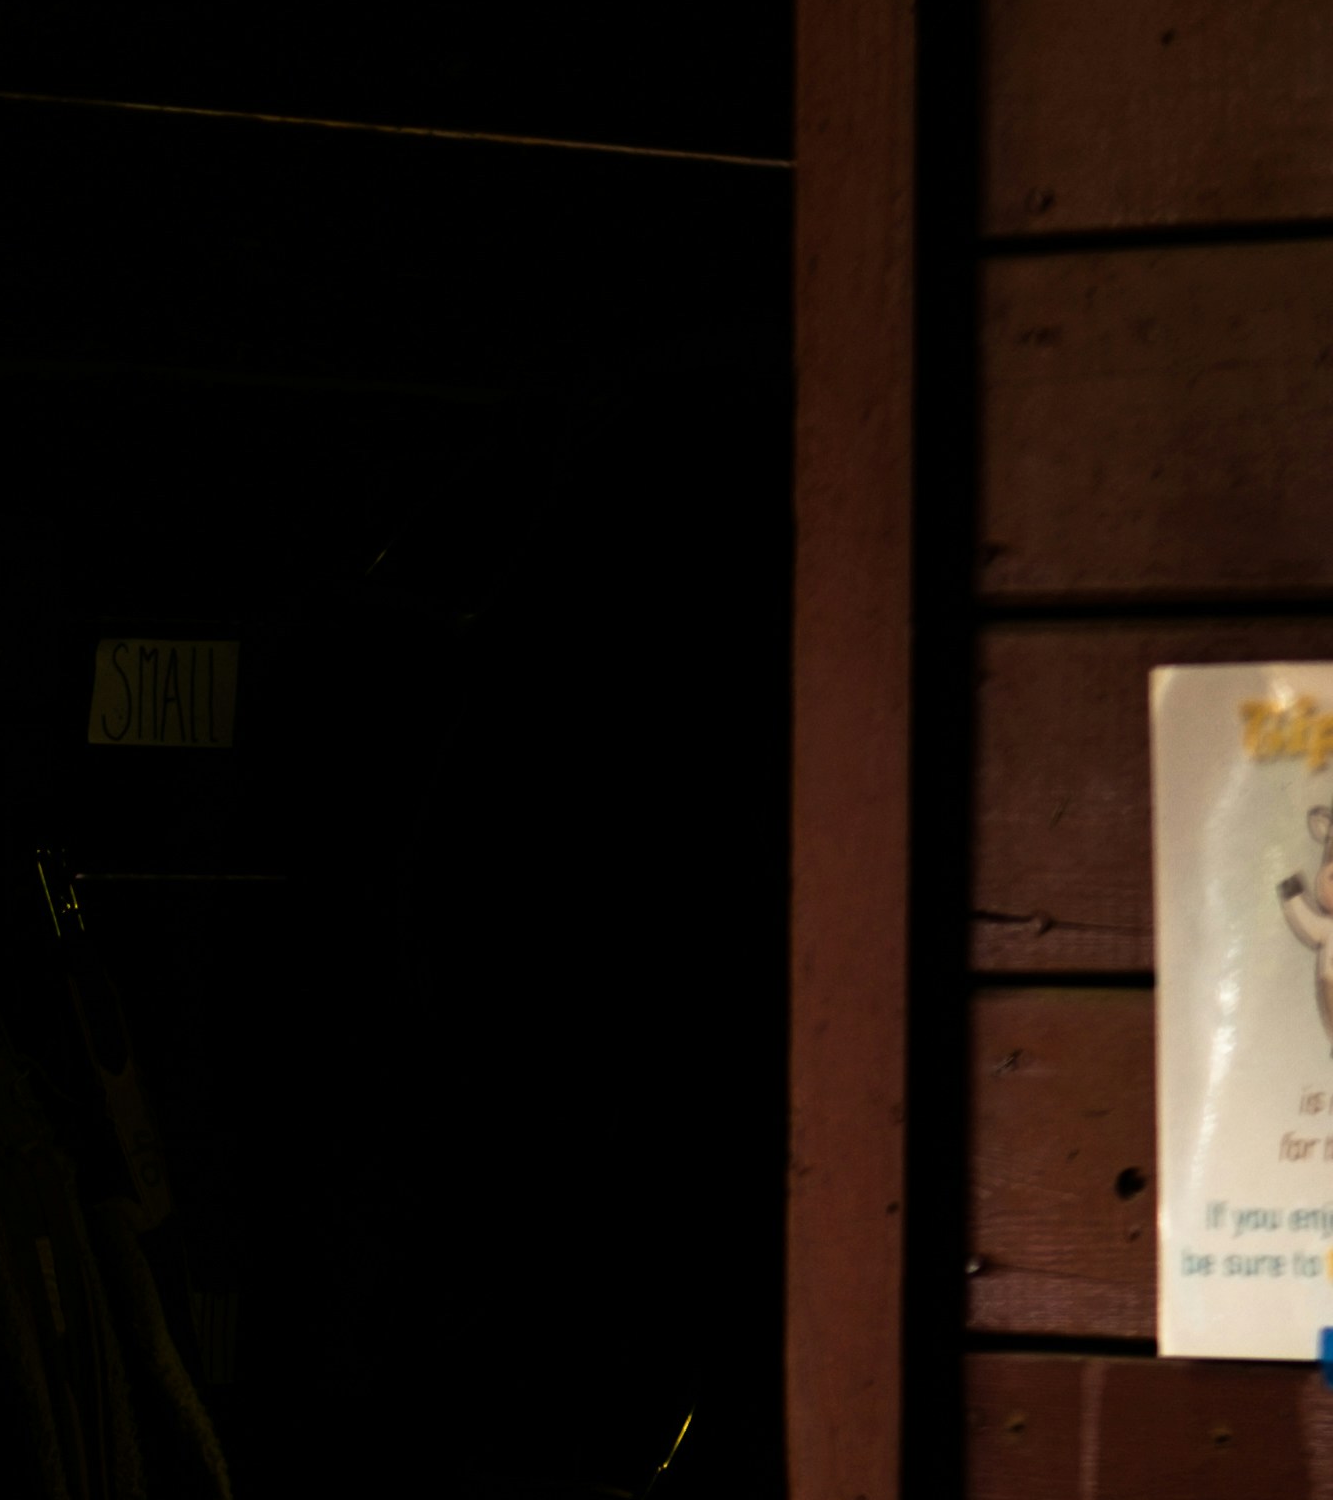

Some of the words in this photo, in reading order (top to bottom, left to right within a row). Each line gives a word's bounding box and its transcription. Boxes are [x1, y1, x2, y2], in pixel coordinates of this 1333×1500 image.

[101, 641, 220, 743] SMALL
[1278, 1130, 1321, 1163] for
[1232, 1208, 1279, 1238] you
[1181, 1248, 1213, 1278] be
[1222, 1254, 1285, 1278] sure
[1292, 1251, 1322, 1278] to
